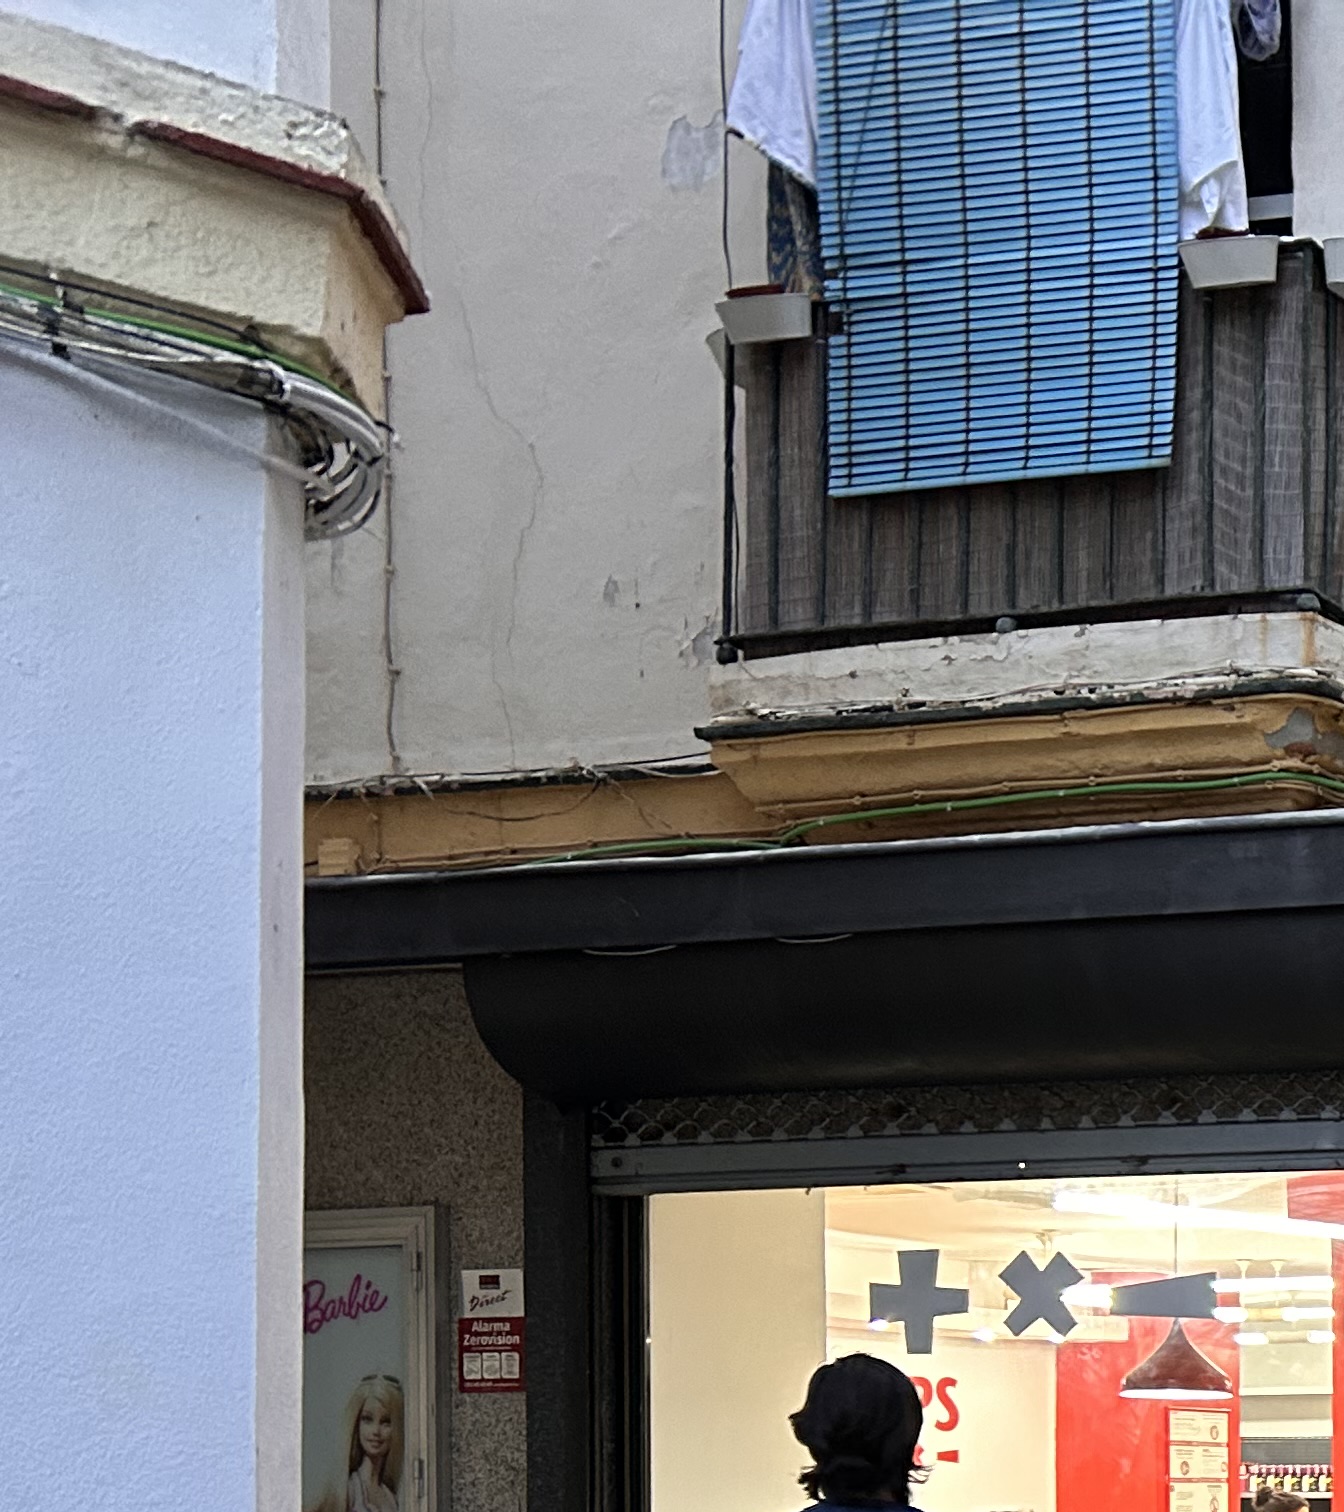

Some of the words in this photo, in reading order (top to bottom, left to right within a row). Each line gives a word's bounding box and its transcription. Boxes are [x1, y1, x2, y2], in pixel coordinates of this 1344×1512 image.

[303, 1273, 388, 1334] Barbie
[472, 1320, 511, 1333] Alarma
[463, 1333, 520, 1347] Zerovision
